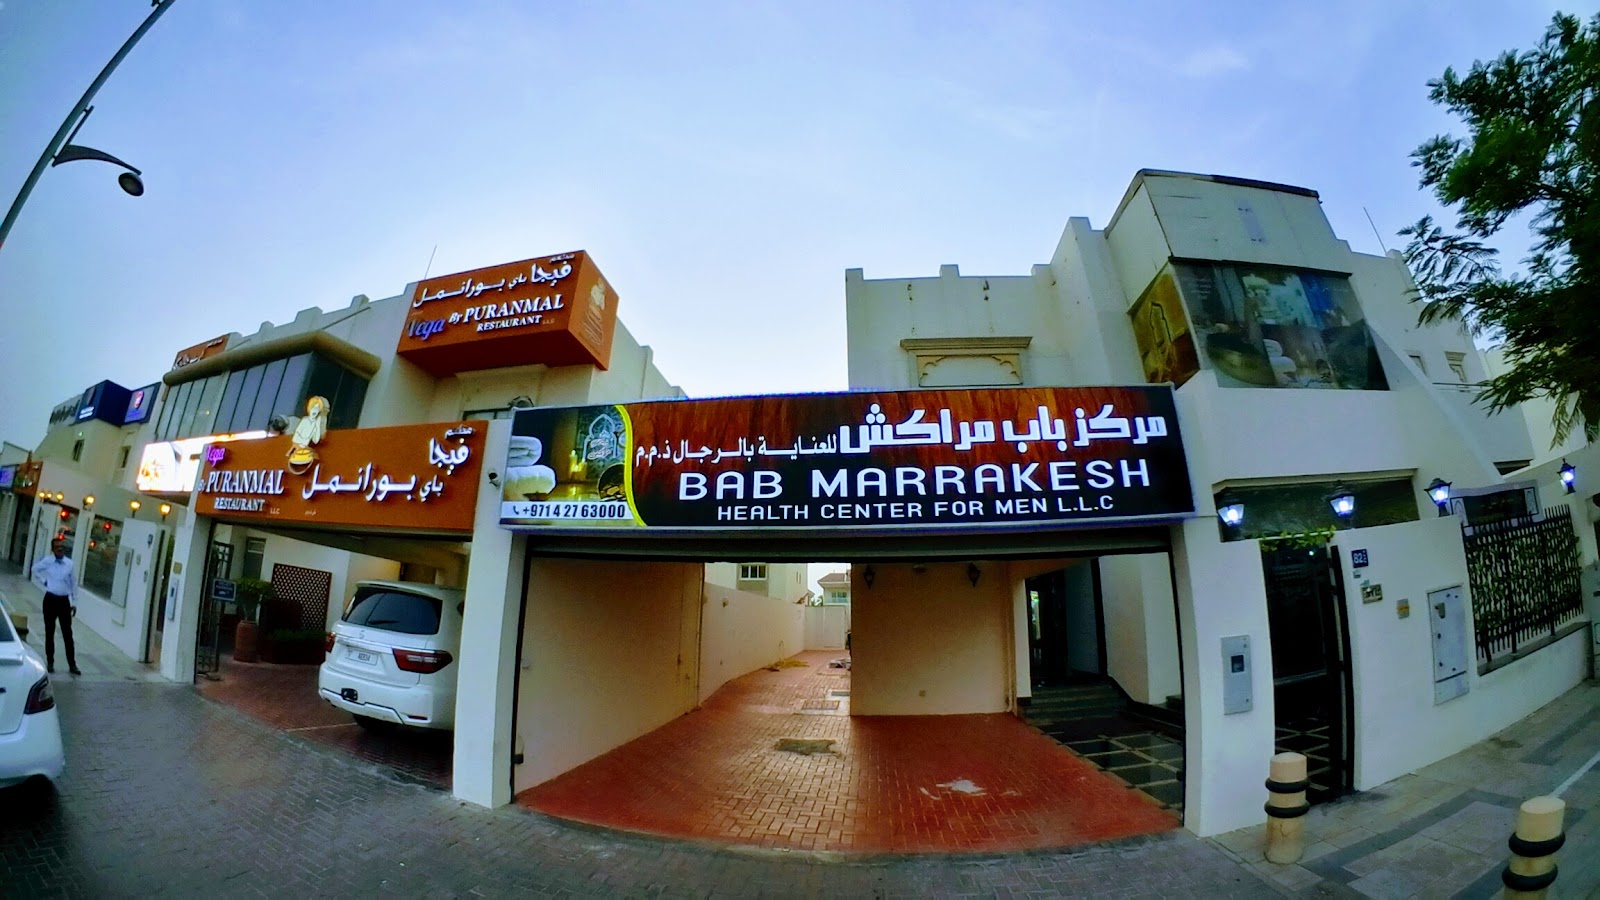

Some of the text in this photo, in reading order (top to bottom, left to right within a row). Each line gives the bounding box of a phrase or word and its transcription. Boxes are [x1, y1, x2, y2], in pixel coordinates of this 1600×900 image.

[531, 260, 572, 287] فيجا
[463, 294, 564, 323] PURANMAL
[476, 314, 542, 332] RESTAURANT
[839, 403, 996, 454] مراكش
[1003, 405, 1068, 454] باب
[1073, 404, 1168, 447] مركز
[429, 437, 470, 476] فيجا
[672, 436, 755, 464] بالرجال
[758, 433, 837, 460] للعناية
[206, 469, 285, 495] PURANMAL
[302, 461, 444, 502] باي بورانمل
[679, 458, 1151, 501] BAB MARRAKESH
[213, 497, 266, 512] RESTAURANT
[717, 495, 1115, 522] HEALTH CENTER FOR MEN L.L.C
